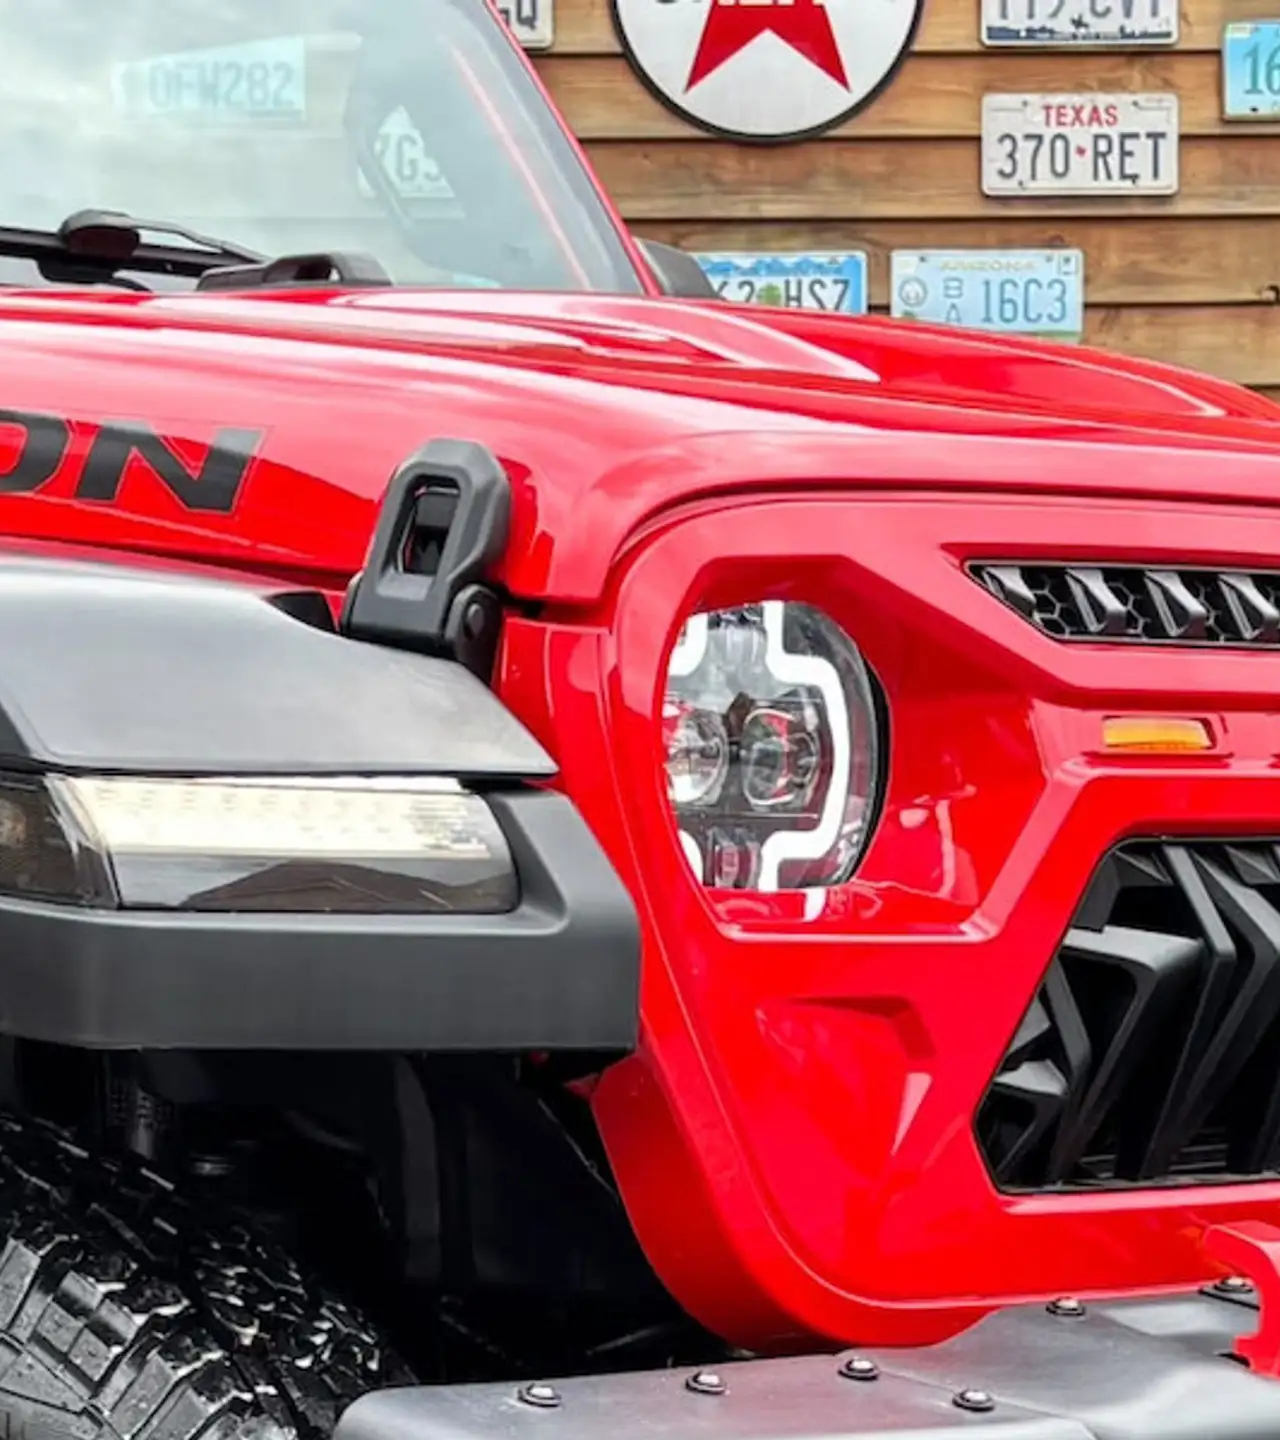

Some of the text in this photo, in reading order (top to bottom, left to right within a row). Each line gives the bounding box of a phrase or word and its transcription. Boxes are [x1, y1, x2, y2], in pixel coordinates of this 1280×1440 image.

[1042, 105, 1118, 127] TEXAS
[997, 131, 1167, 182] 370 RET
[981, 277, 1068, 324] 16C3
